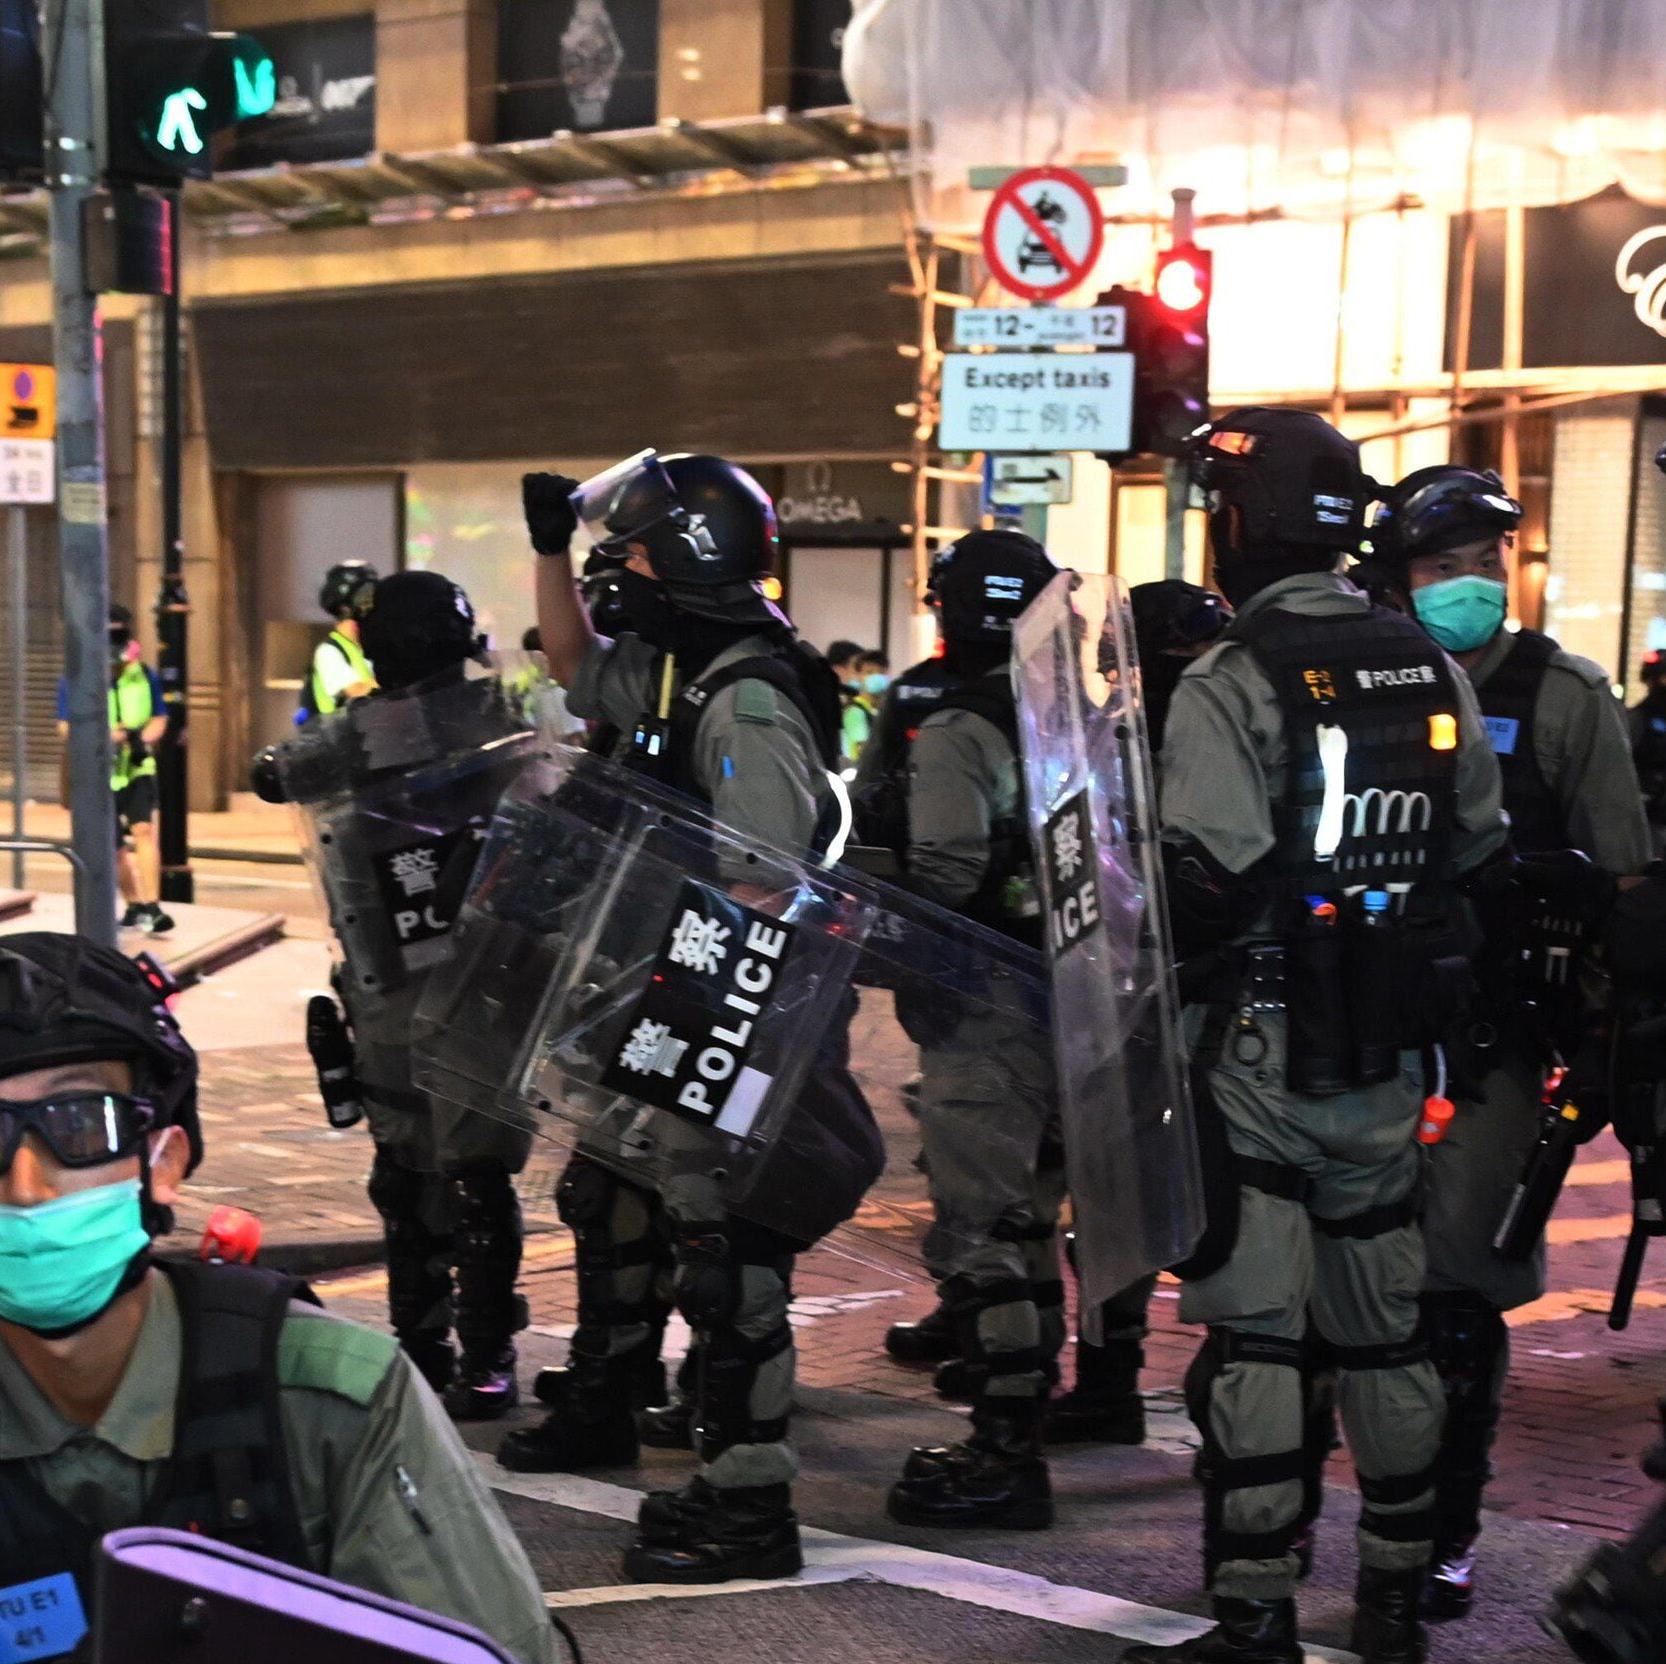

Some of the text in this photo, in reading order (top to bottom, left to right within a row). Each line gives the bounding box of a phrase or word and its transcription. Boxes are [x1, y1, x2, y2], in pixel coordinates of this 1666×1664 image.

[1092, 314, 1117, 336] 12
[964, 366, 1111, 391] Except taxis
[967, 403, 1101, 433] 的士例外
[777, 496, 862, 522] OMEGA
[677, 920, 788, 1116] POLICE
